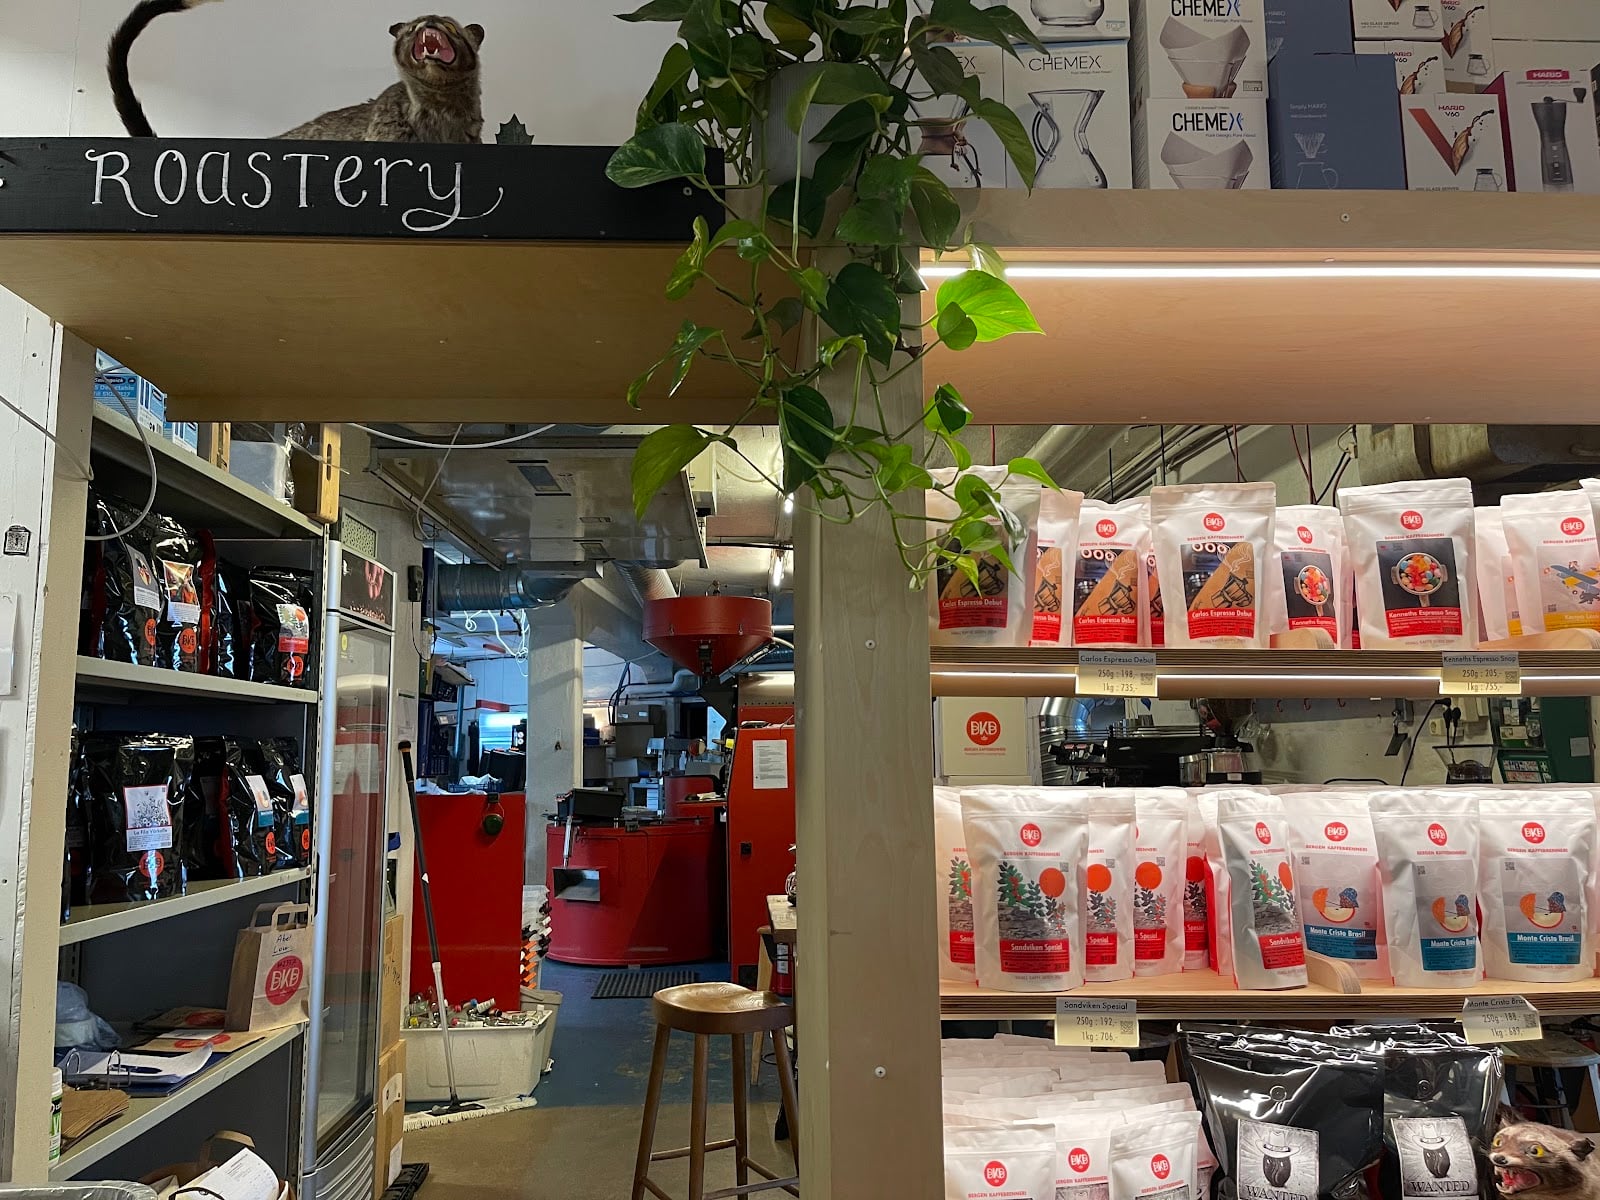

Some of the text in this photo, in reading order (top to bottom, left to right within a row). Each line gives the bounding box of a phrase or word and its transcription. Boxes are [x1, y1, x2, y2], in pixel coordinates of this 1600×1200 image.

[1171, 0, 1242, 16] CHEMEX
[1028, 56, 1102, 71] CHEMEX
[1172, 113, 1244, 131] CHEMEX
[86, 149, 504, 232] Roastery
[1403, 515, 1422, 525] BKB
[1098, 524, 1115, 534] BKB
[1563, 521, 1582, 531] BKB
[1103, 656, 1132, 664] Espresso
[1473, 655, 1498, 664] Espresso
[1098, 669, 1114, 679] 250g
[1463, 669, 1478, 679] 250g
[1103, 683, 1114, 692] 1kg
[1467, 683, 1478, 692] 1kg
[970, 721, 998, 736] BKB
[1023, 830, 1040, 840] BKB
[1327, 827, 1346, 836] BKB
[1524, 827, 1543, 838] BKB
[1011, 943, 1063, 952] Sandviken Spesial
[270, 968, 300, 991] BKB
[1077, 1016, 1093, 1027] 250g
[1482, 1014, 1500, 1024] 250g
[1082, 1032, 1093, 1042] 1kg
[1491, 1028, 1504, 1038] 1kg
[1070, 1154, 1088, 1166] BKB
[1153, 1159, 1168, 1173] BKB
[987, 1168, 1005, 1179] BKB
[1411, 1180, 1470, 1192] WANTED
